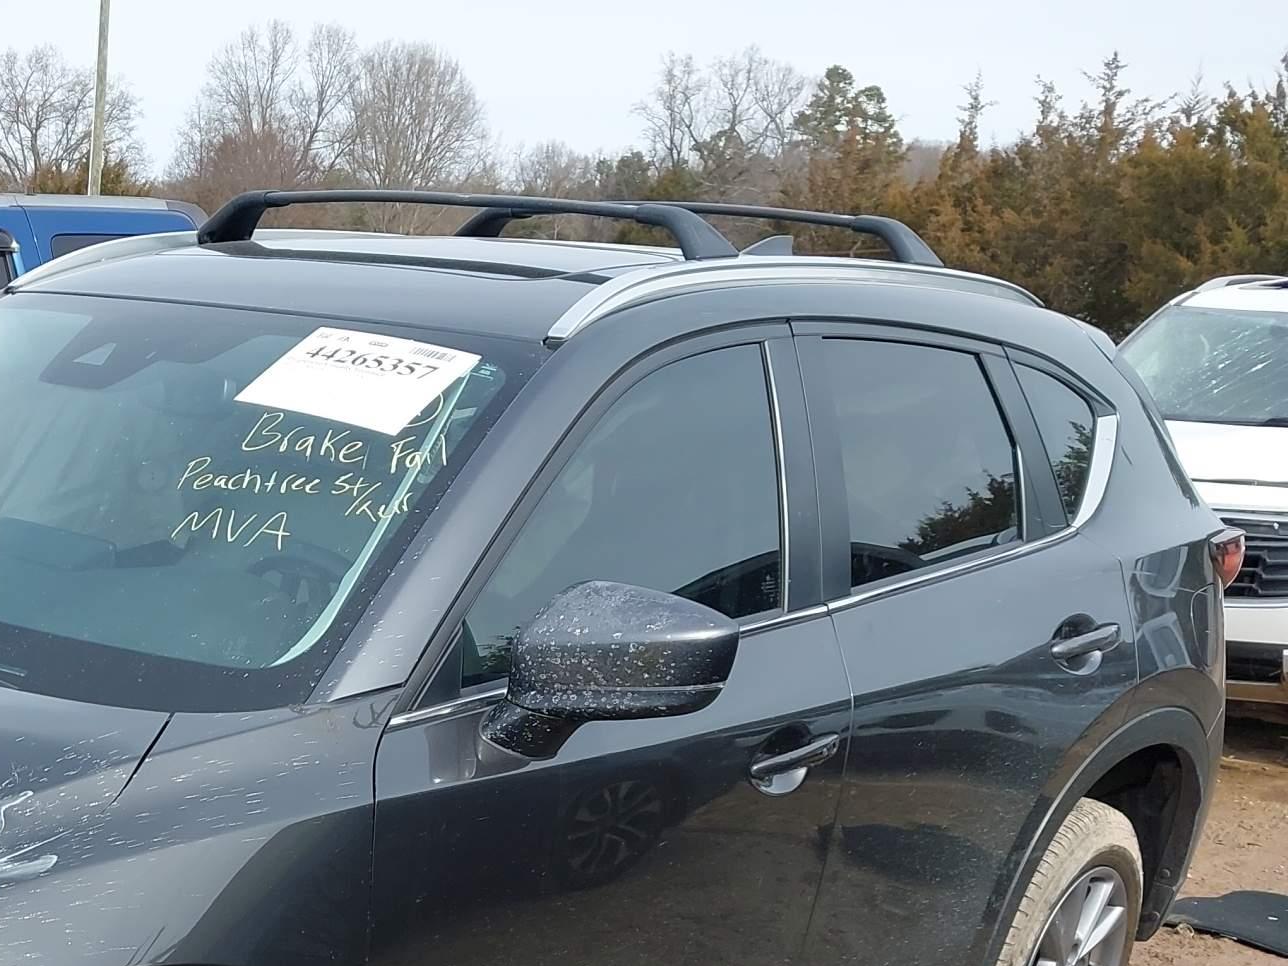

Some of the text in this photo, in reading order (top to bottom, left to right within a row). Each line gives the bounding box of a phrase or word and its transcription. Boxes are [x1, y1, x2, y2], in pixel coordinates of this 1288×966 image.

[305, 345, 441, 380] 44265357
[241, 411, 367, 464] Brake
[177, 456, 321, 494] Peachtree
[170, 507, 292, 551] MVA
